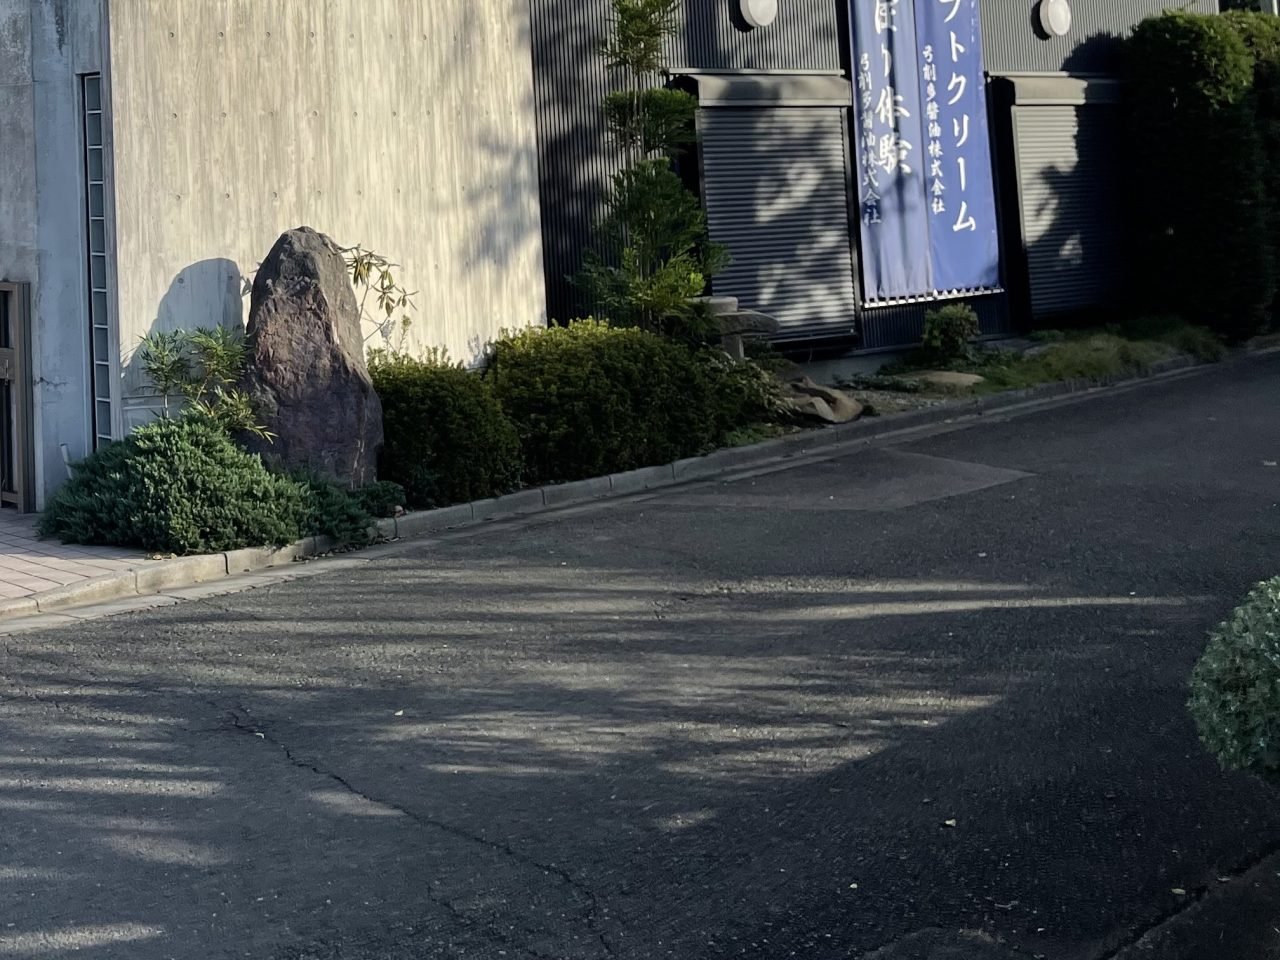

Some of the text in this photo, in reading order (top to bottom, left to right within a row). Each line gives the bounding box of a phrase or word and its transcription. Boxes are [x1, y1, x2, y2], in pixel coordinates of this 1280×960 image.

[922, 44, 946, 216] 弓削多醤油株式会社
